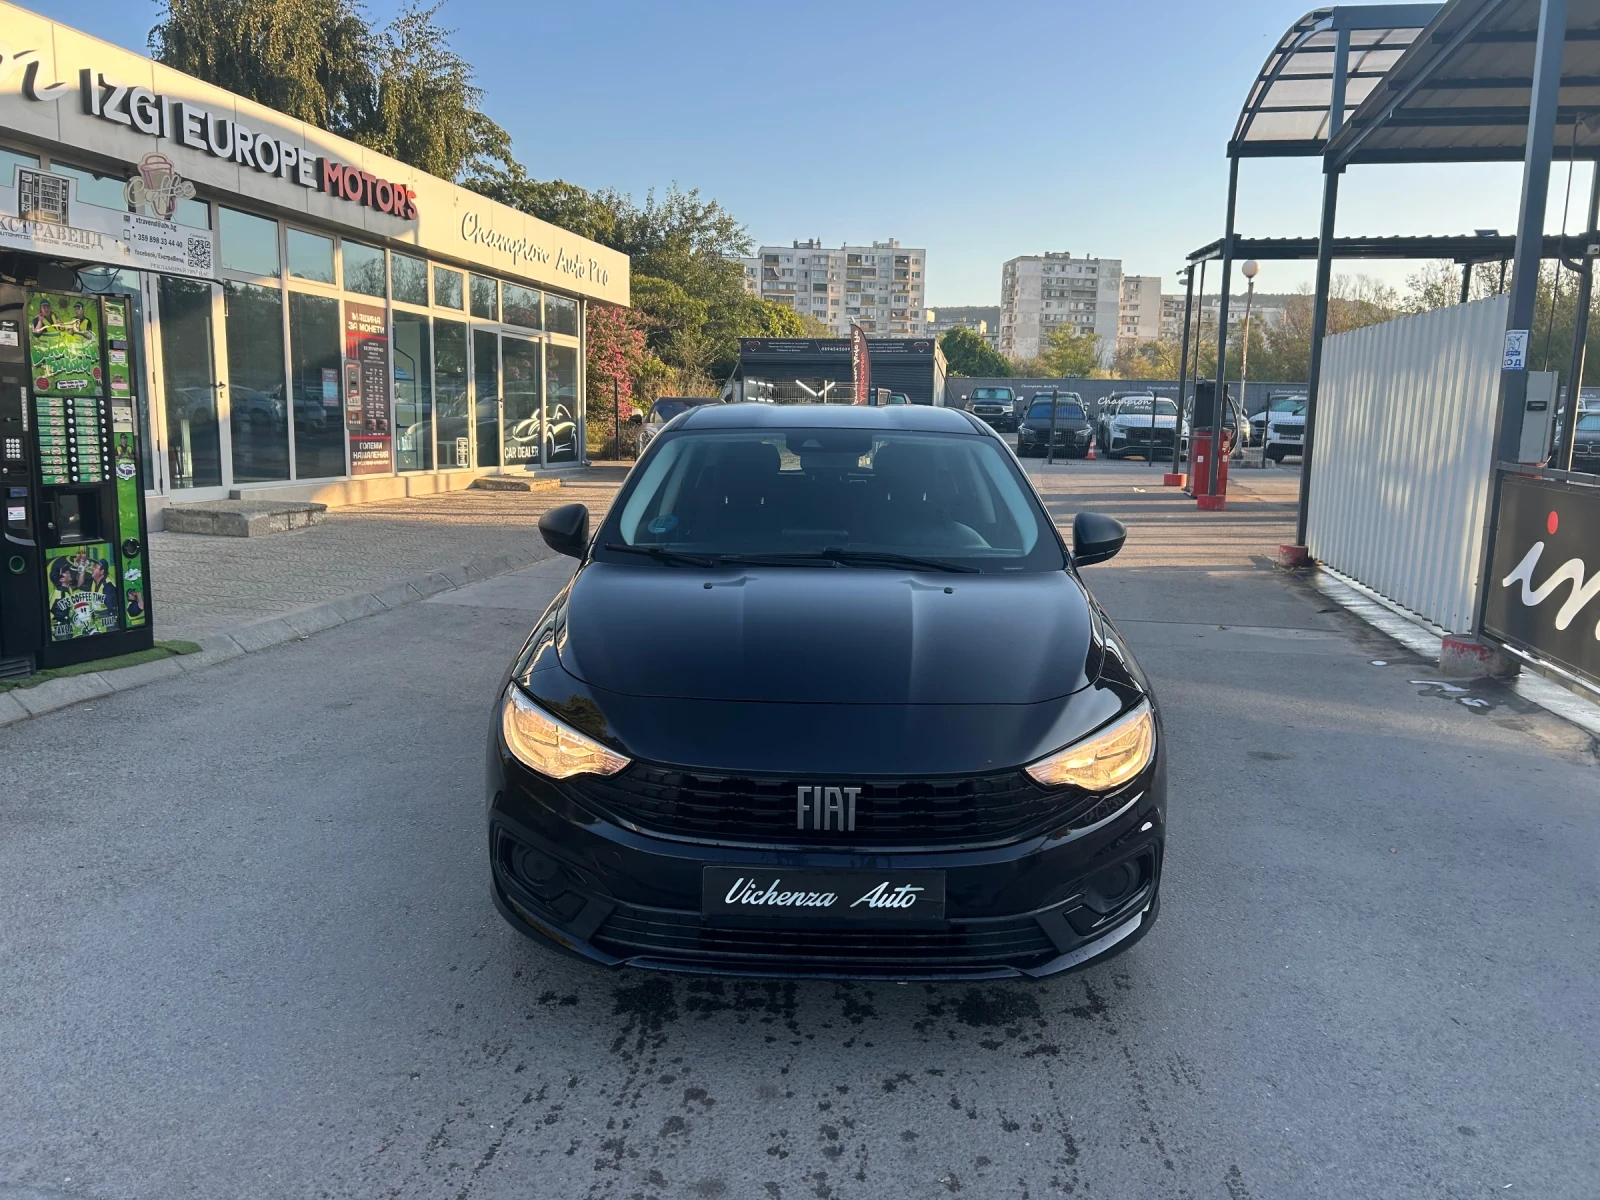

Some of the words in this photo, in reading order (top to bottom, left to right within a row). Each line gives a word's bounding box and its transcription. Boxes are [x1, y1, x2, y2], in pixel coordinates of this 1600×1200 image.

[80, 68, 170, 138] IZGI
[176, 103, 317, 189] EUROPE
[126, 174, 196, 210] Coffee
[138, 233, 149, 242] 359
[160, 238, 168, 246] 33
[168, 239, 176, 247] 44
[176, 240, 183, 248] 40
[461, 211, 550, 265] Champion
[555, 247, 585, 280] Auto
[588, 257, 609, 287] Pro
[351, 312, 381, 325] МАШИНА
[347, 321, 358, 330] ЗА
[358, 323, 385, 334] МОНЕТИ
[1097, 396, 1152, 406] Champion
[359, 441, 383, 450] ГОЛЕМИ
[504, 446, 517, 459] CAR
[517, 445, 539, 458] DEALER
[71, 591, 92, 604] COFFEE
[92, 592, 106, 604] TIME
[797, 786, 862, 832] FIAT
[724, 877, 838, 907] Vichenza
[850, 881, 925, 909] Auto
